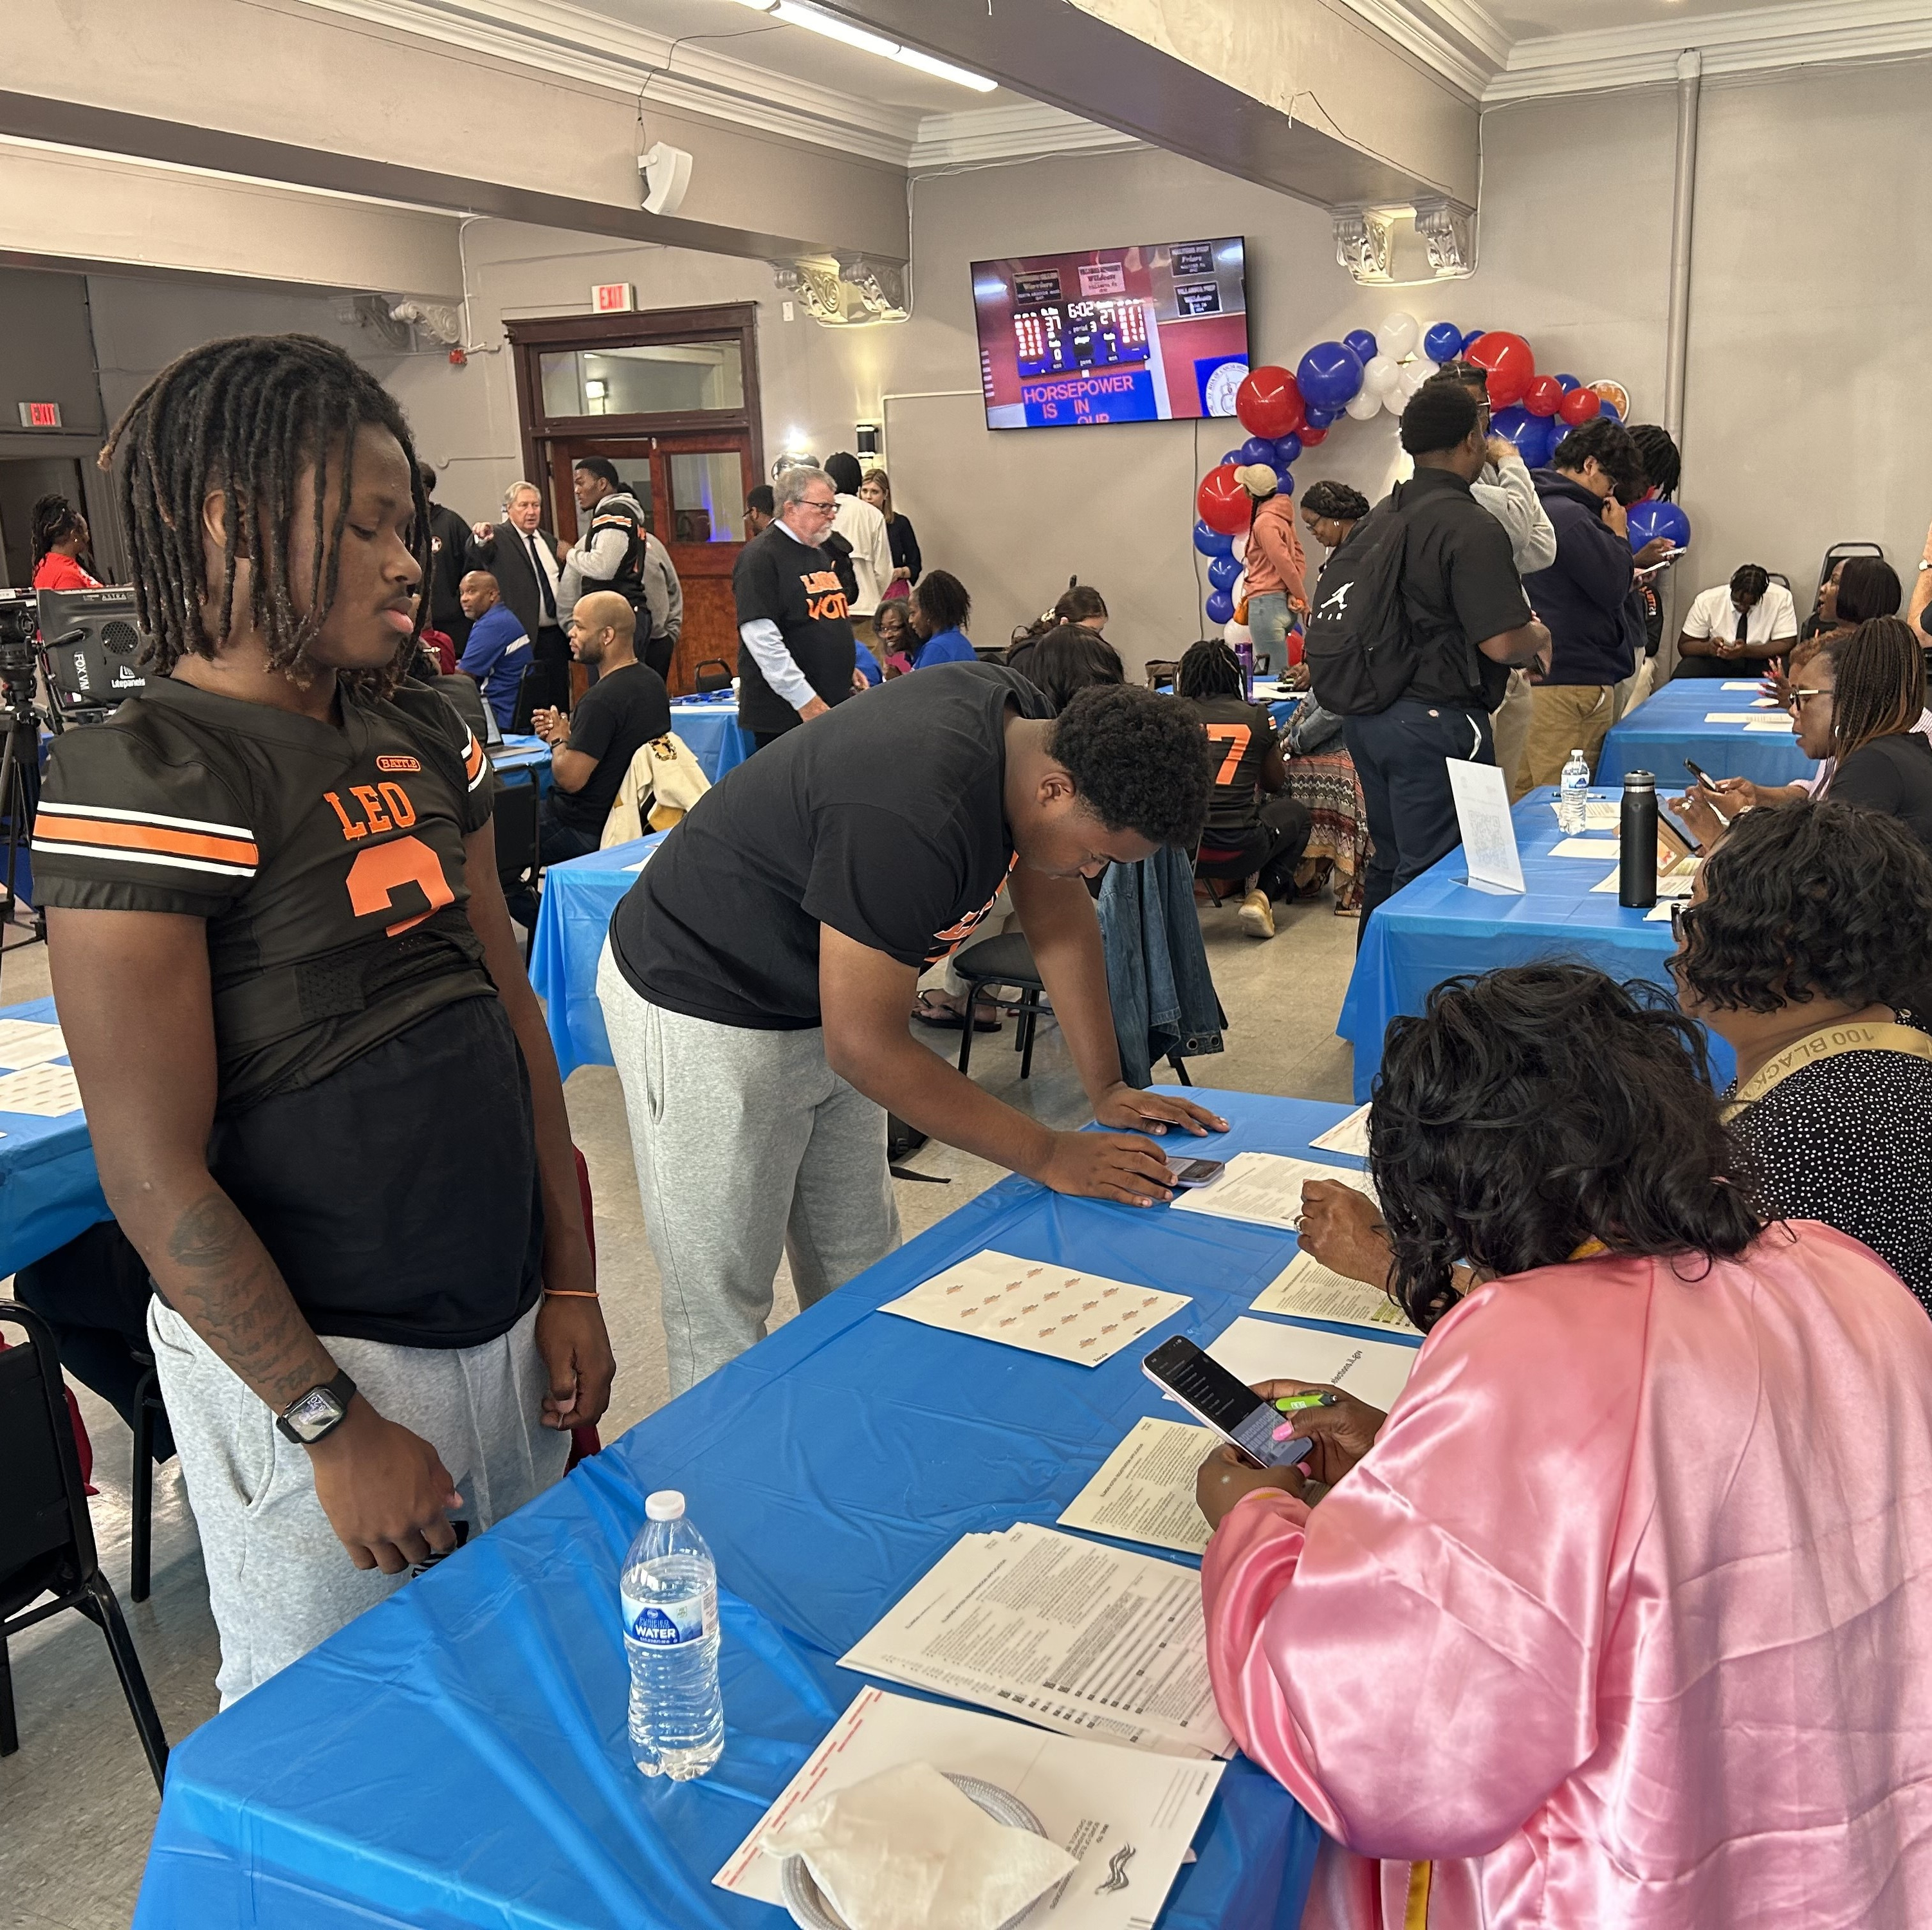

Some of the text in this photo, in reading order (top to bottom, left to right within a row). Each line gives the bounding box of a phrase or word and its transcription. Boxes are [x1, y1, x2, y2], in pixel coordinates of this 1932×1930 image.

[599, 285, 623, 310] EXIT
[1068, 301, 1094, 318] 6:02
[1100, 308, 1116, 324] 27
[1045, 316, 1062, 331] 37
[1024, 376, 1134, 404] HORSEPOWER
[30, 403, 55, 425] EXIT
[1043, 398, 1090, 419] IS IN
[805, 592, 850, 620] VOT
[74, 653, 86, 674] FOX
[111, 677, 146, 689] Litepanels
[381, 758, 418, 769] BATTLE
[323, 782, 417, 841] LEO
[1754, 1028, 1875, 1089] 100 BLACK
[635, 1624, 676, 1639] WATER
